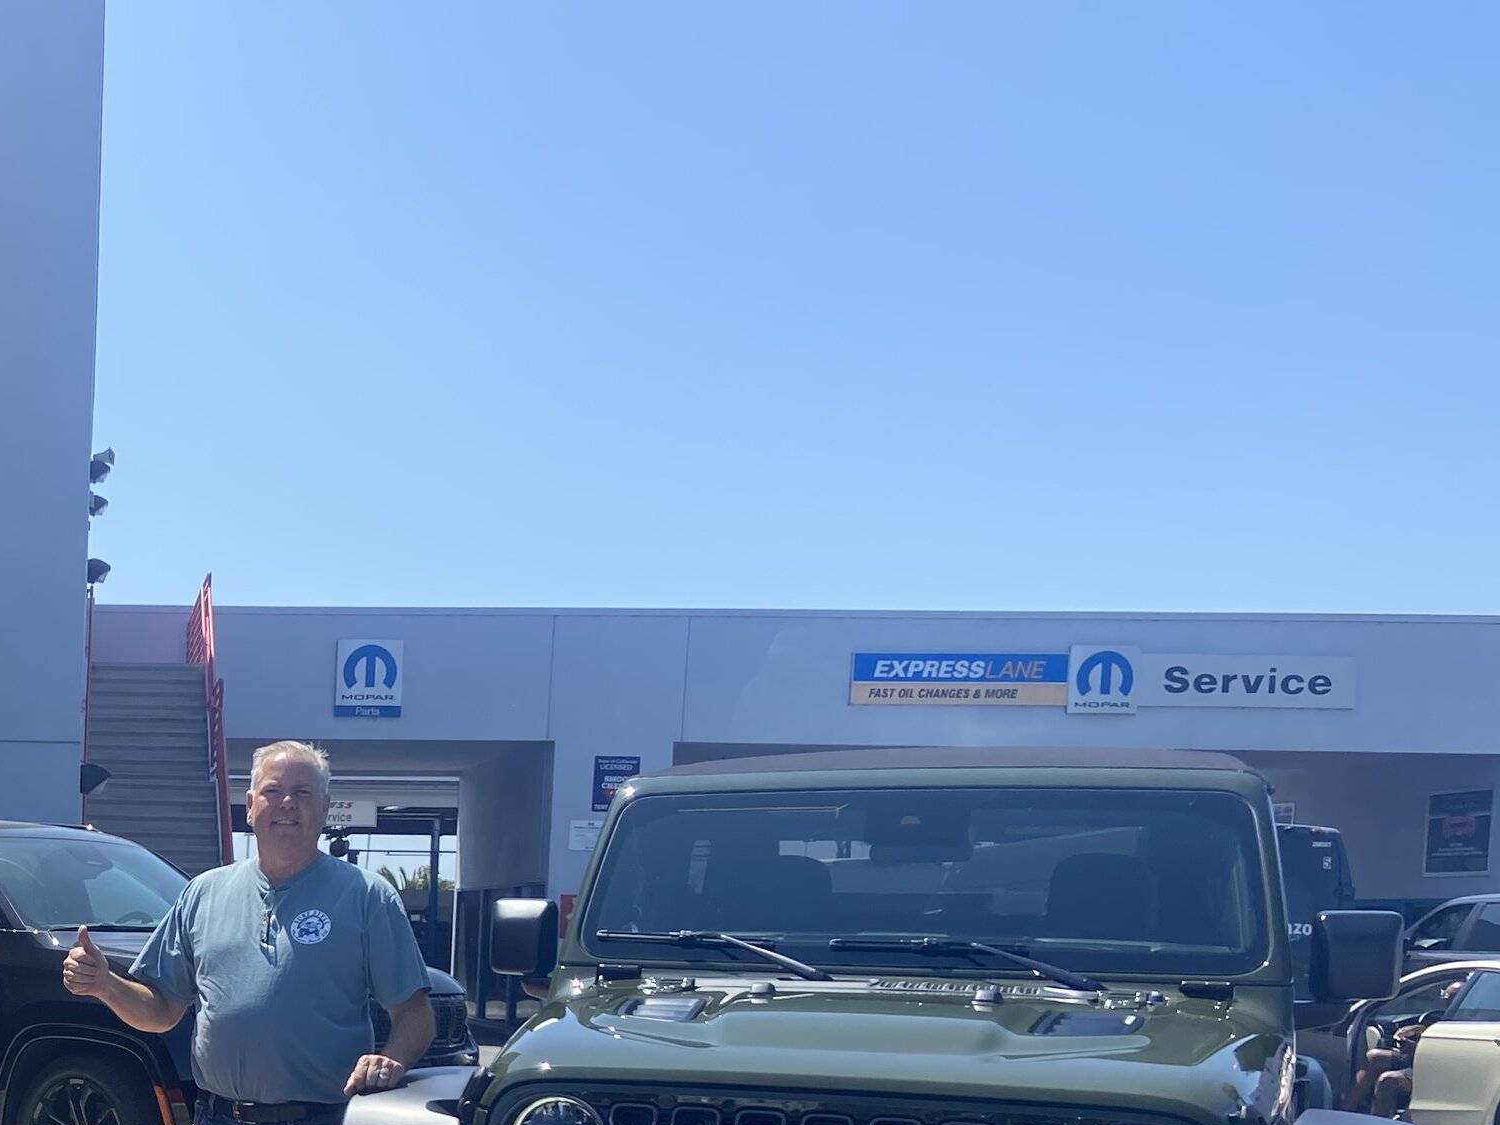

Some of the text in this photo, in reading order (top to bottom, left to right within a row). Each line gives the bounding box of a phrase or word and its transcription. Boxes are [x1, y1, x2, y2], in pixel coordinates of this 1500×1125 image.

[1163, 665, 1332, 695] Service
[868, 688, 1018, 700] FAST OIL CHANGES & MORE
[1074, 701, 1130, 709] MOPAR
[355, 706, 380, 716] Parts
